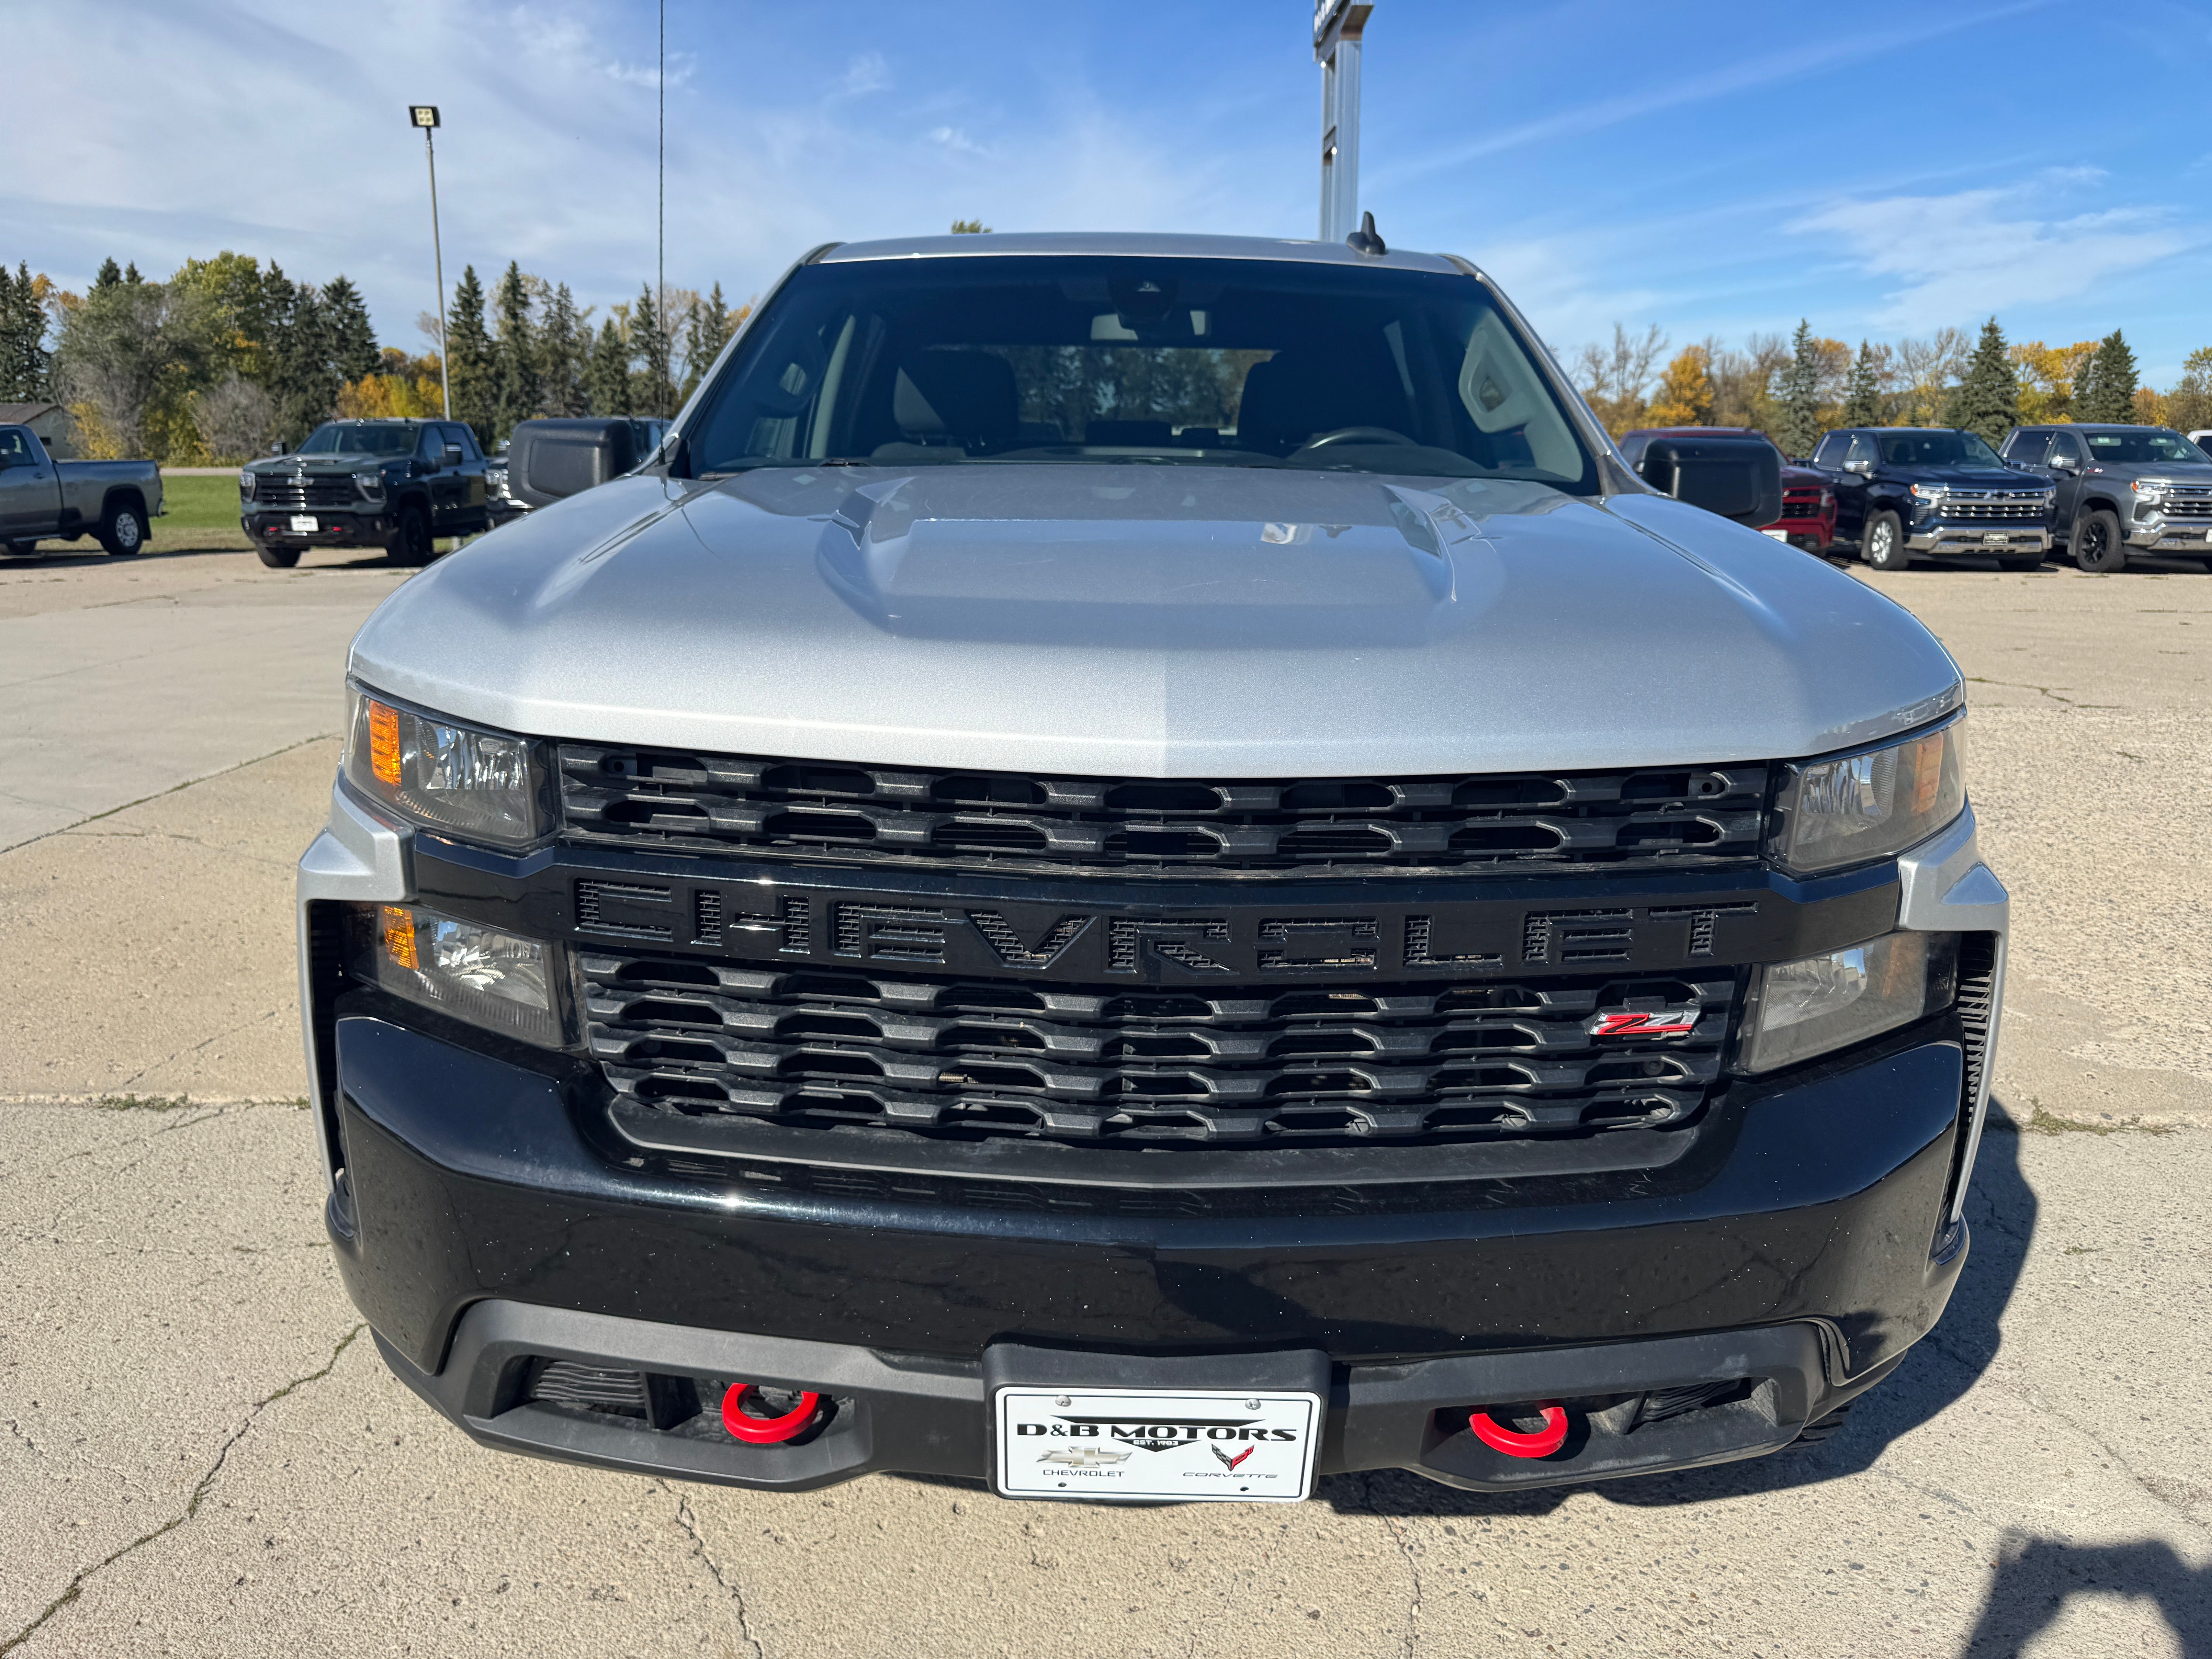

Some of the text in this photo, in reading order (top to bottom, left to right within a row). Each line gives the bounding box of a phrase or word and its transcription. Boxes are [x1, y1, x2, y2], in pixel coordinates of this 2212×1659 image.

[574, 877, 1760, 973] CHEVROLET
[1589, 1009, 1701, 1036] Z71
[1017, 1423, 1297, 1441] D&B MOTORS
